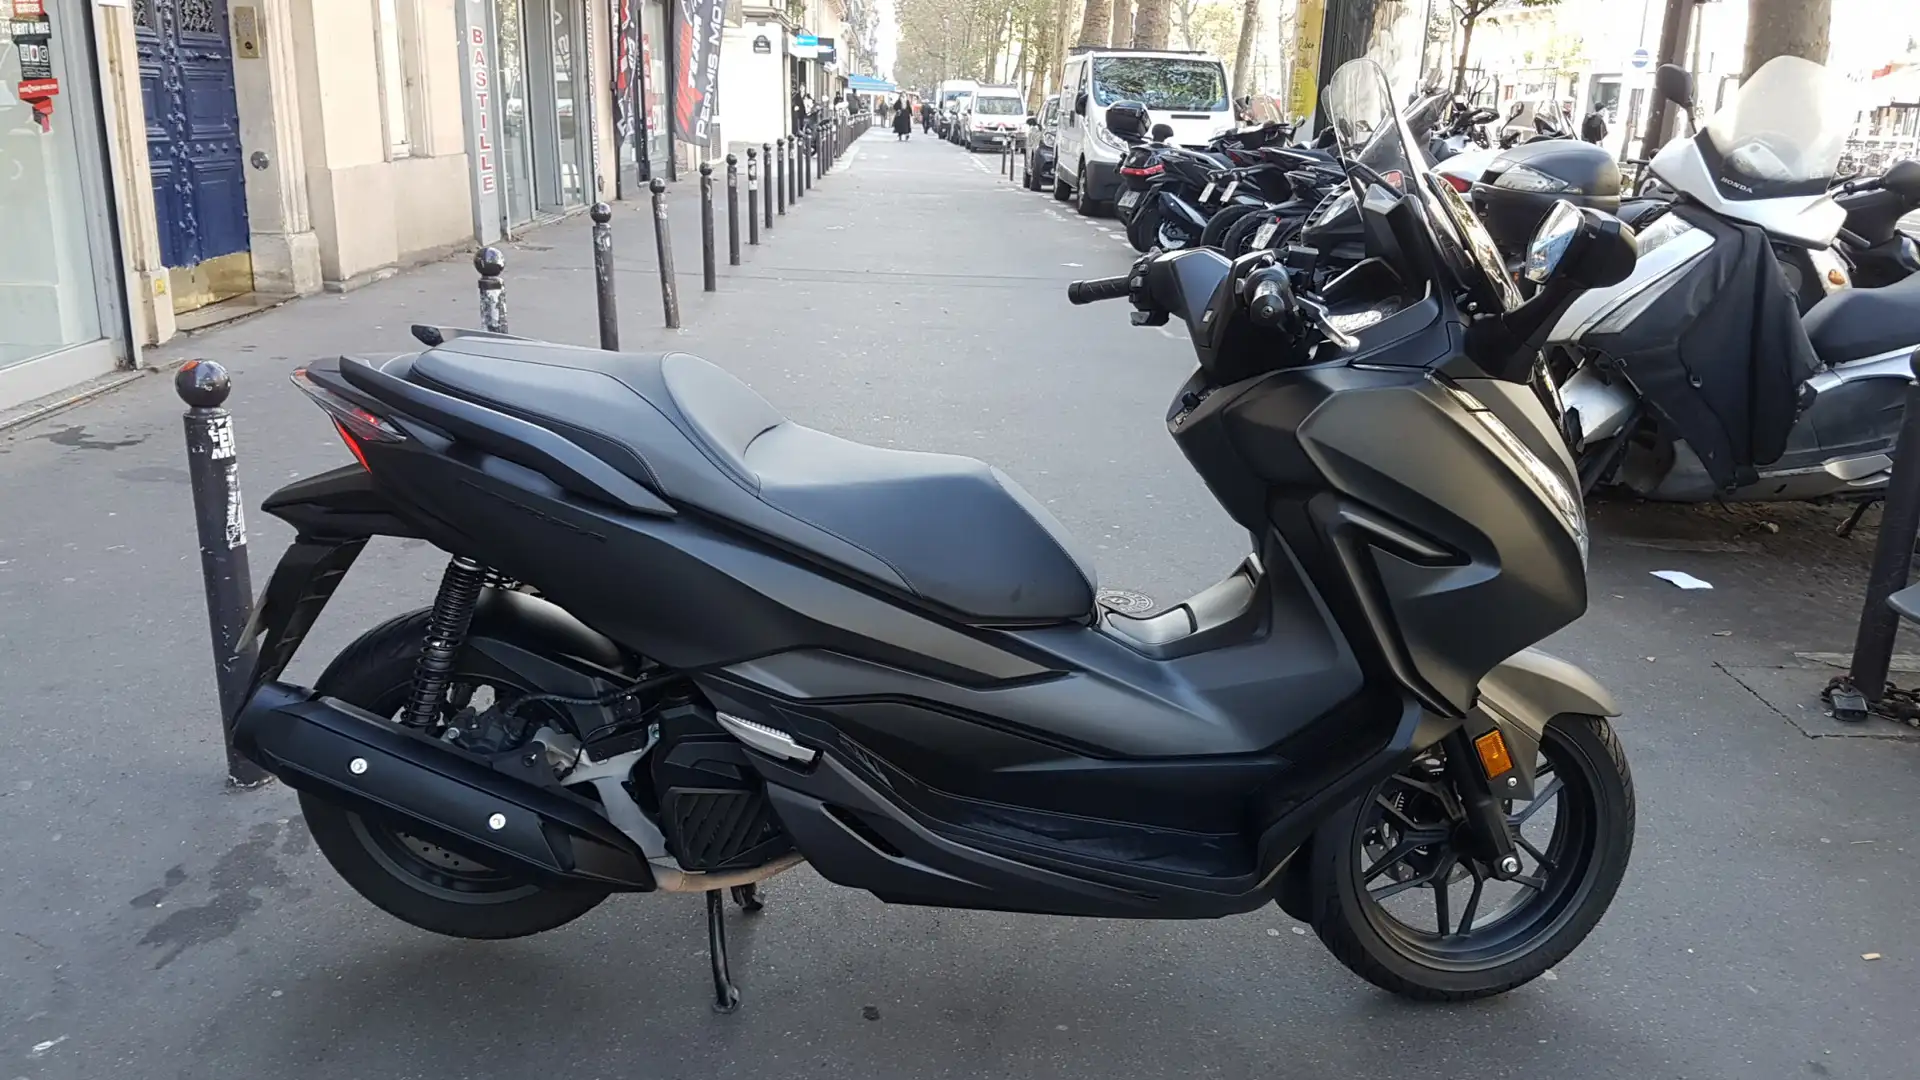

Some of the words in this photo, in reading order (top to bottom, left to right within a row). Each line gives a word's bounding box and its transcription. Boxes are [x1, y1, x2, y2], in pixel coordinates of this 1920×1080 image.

[688, 14, 702, 88] TEAM
[472, 27, 494, 193] BASTILLE
[696, 53, 717, 139] PERMIS
[1721, 176, 1753, 194] HONDA
